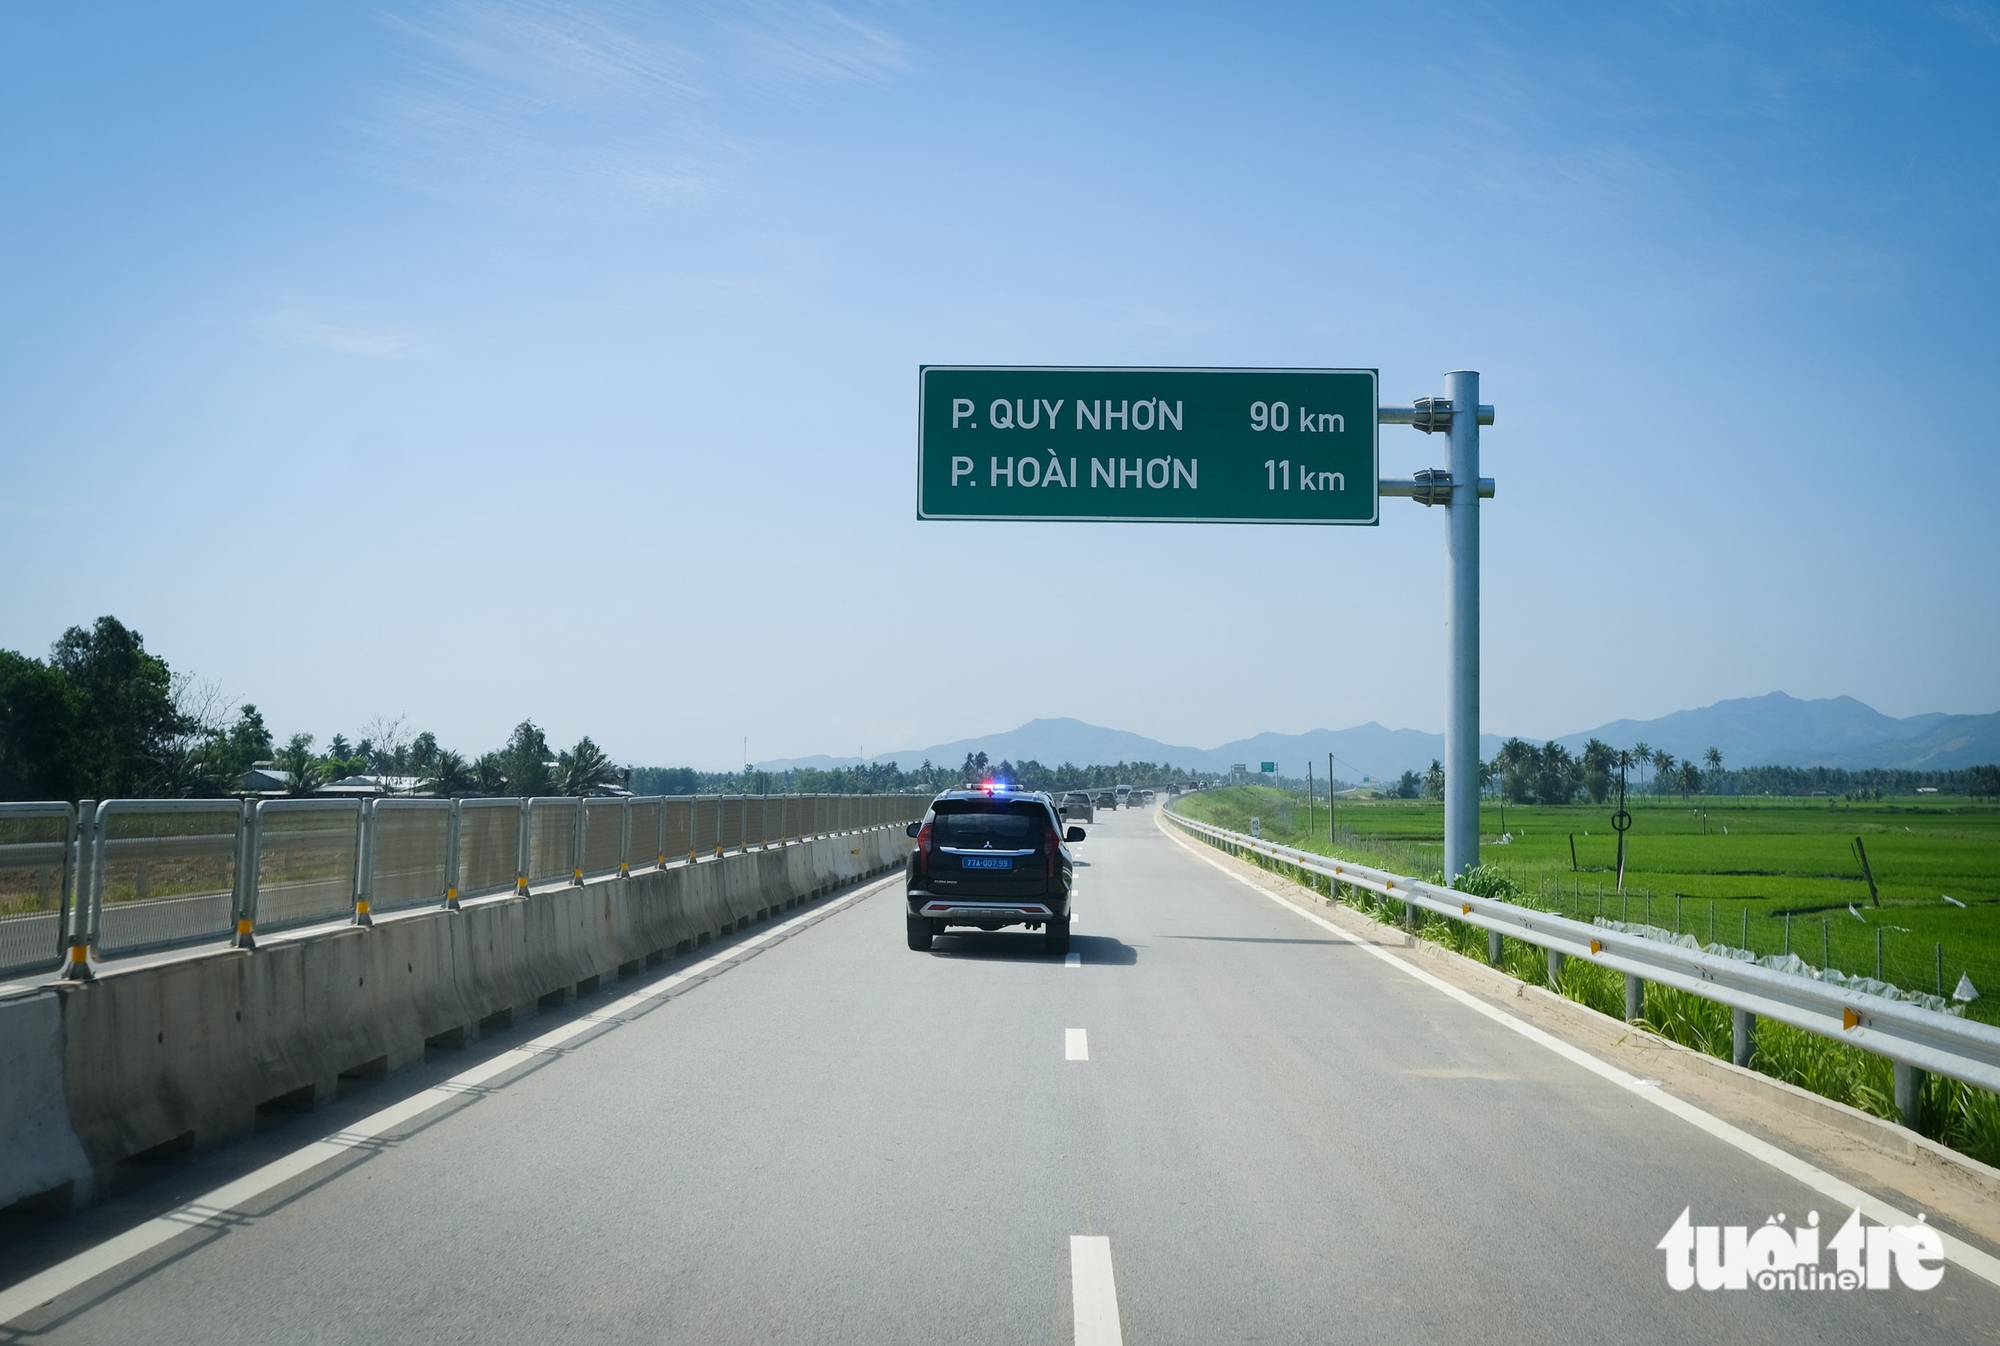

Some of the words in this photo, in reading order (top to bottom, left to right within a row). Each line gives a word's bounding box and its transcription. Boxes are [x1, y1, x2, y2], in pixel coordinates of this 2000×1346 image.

[951, 398, 977, 429] P.
[989, 398, 1065, 430] QUY
[1076, 396, 1183, 431] NHƠN
[1250, 400, 1290, 432] 90
[1300, 406, 1345, 433] km
[951, 455, 977, 487] P.
[989, 448, 1077, 488] HOÀI
[1090, 454, 1198, 489] NHƠN
[1264, 459, 1290, 491] 11
[1300, 464, 1345, 491] km
